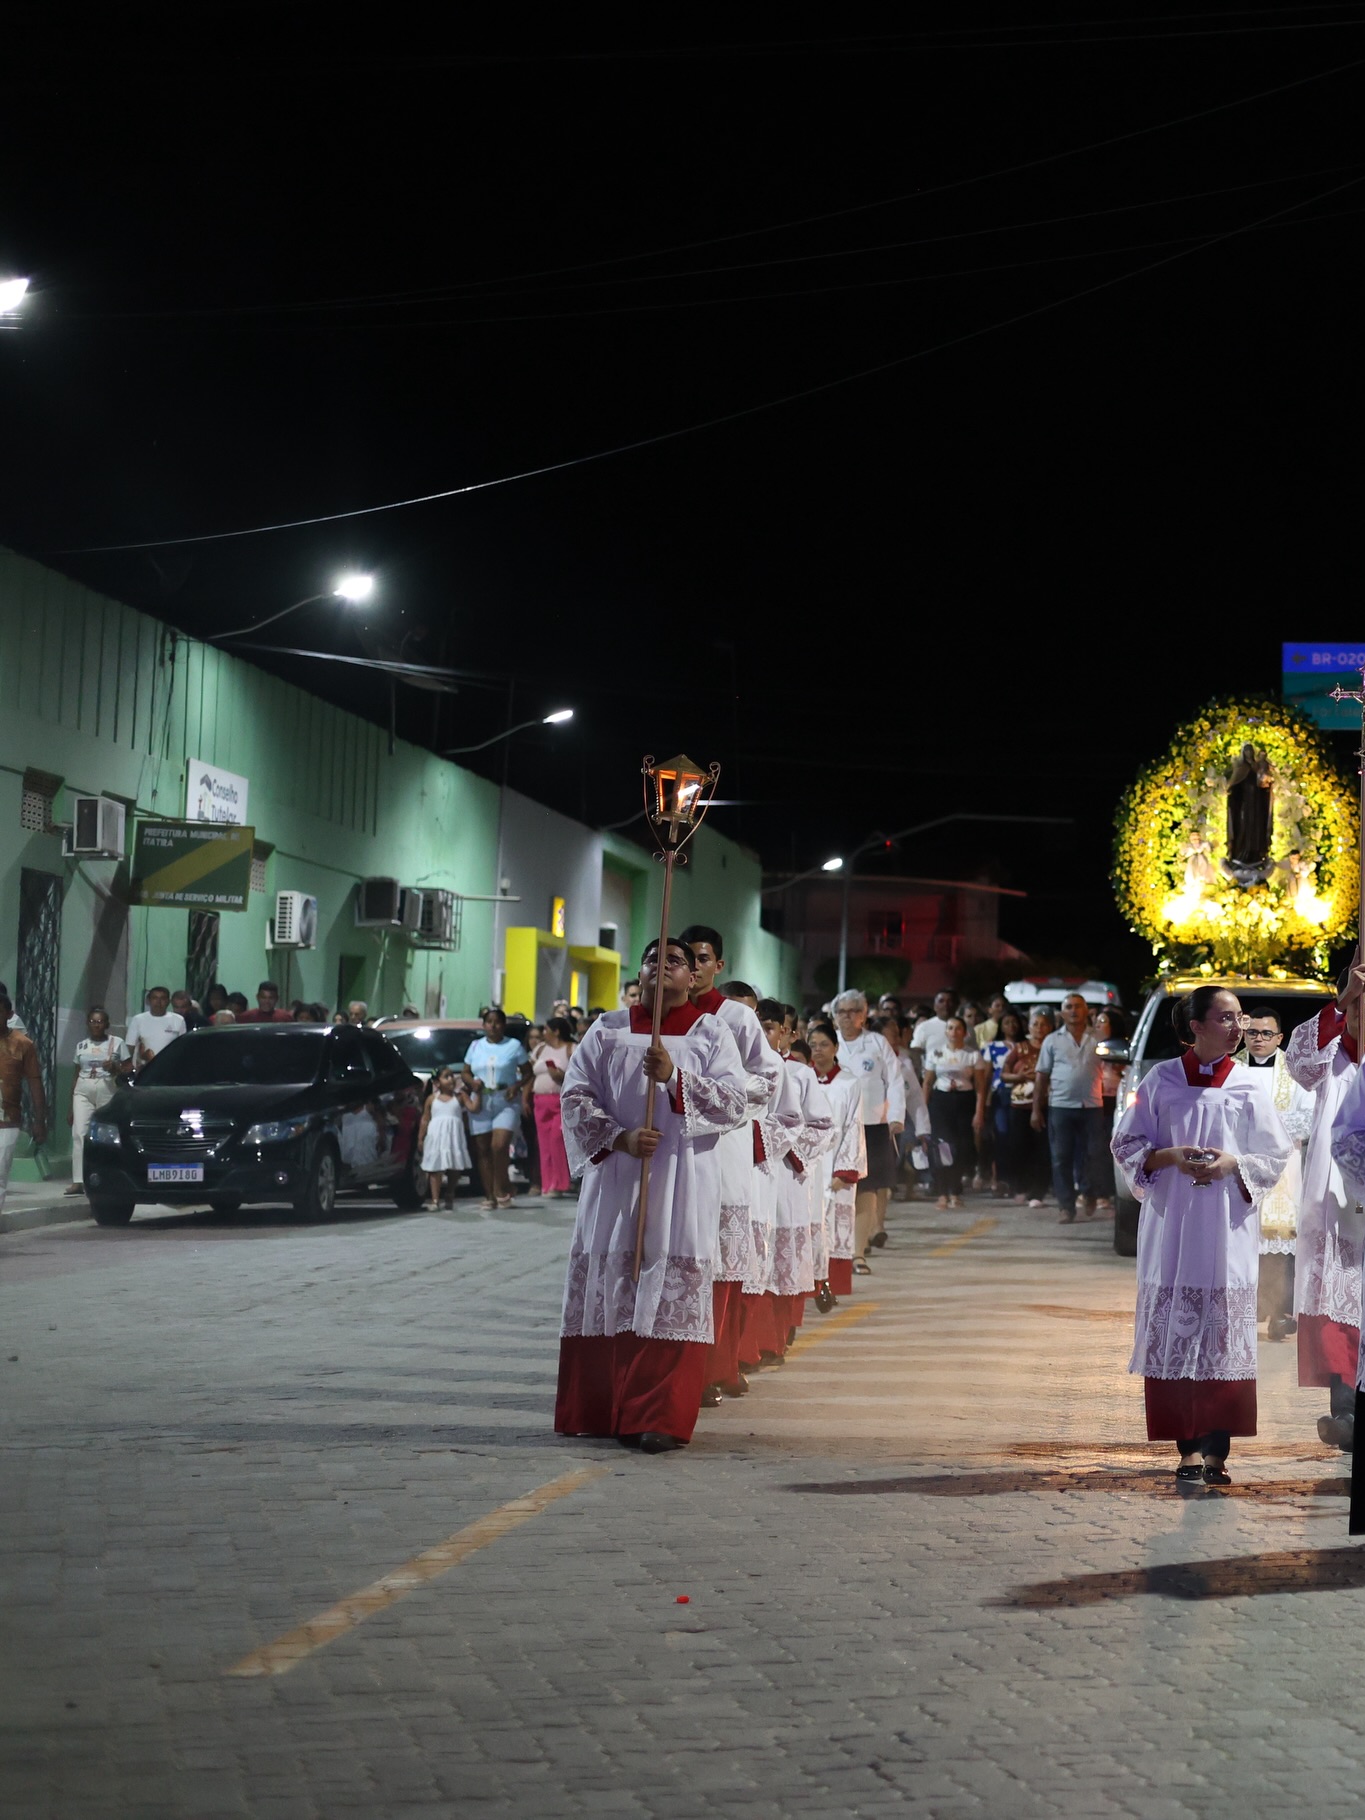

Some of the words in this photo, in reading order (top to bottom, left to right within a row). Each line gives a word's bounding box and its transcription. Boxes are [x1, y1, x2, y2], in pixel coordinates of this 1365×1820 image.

[1311, 652, 1365, 665] BR-020
[212, 778, 238, 804] Conselho
[211, 804, 237, 823] Tutelar
[144, 828, 187, 838] PREFEITURA
[190, 830, 227, 840] MUNICIPAL
[143, 838, 173, 847] ITATIRA
[184, 893, 214, 903] SERVIÇO
[215, 895, 243, 904] MILITAR
